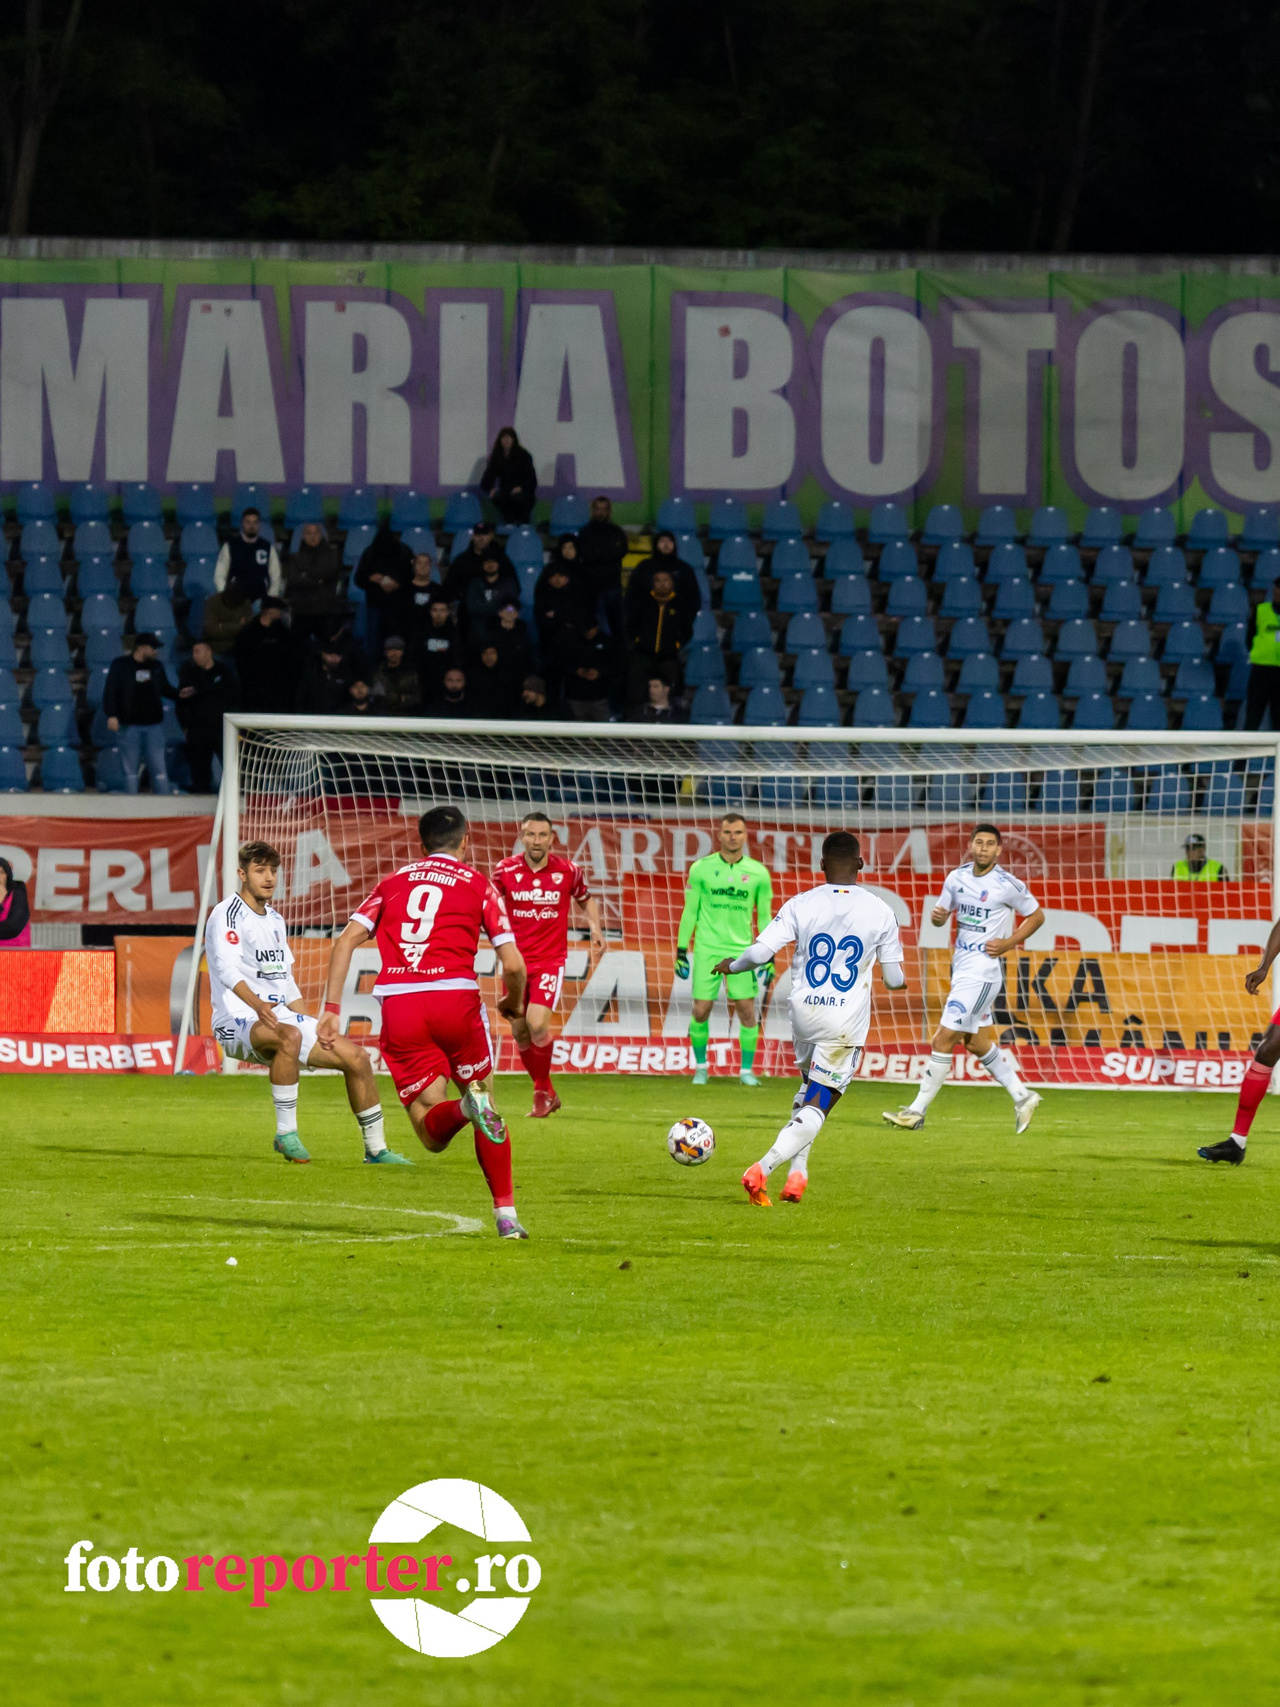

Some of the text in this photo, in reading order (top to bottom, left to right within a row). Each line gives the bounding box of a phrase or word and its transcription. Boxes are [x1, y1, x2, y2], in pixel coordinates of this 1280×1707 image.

[0, 297, 626, 489] MARIA
[408, 871, 457, 887] SELMANI
[401, 884, 443, 943] 9
[805, 932, 864, 993] 83
[539, 972, 558, 993] 23
[0, 1037, 173, 1070] SUPERBET
[1101, 1051, 1252, 1086] SUPERB
